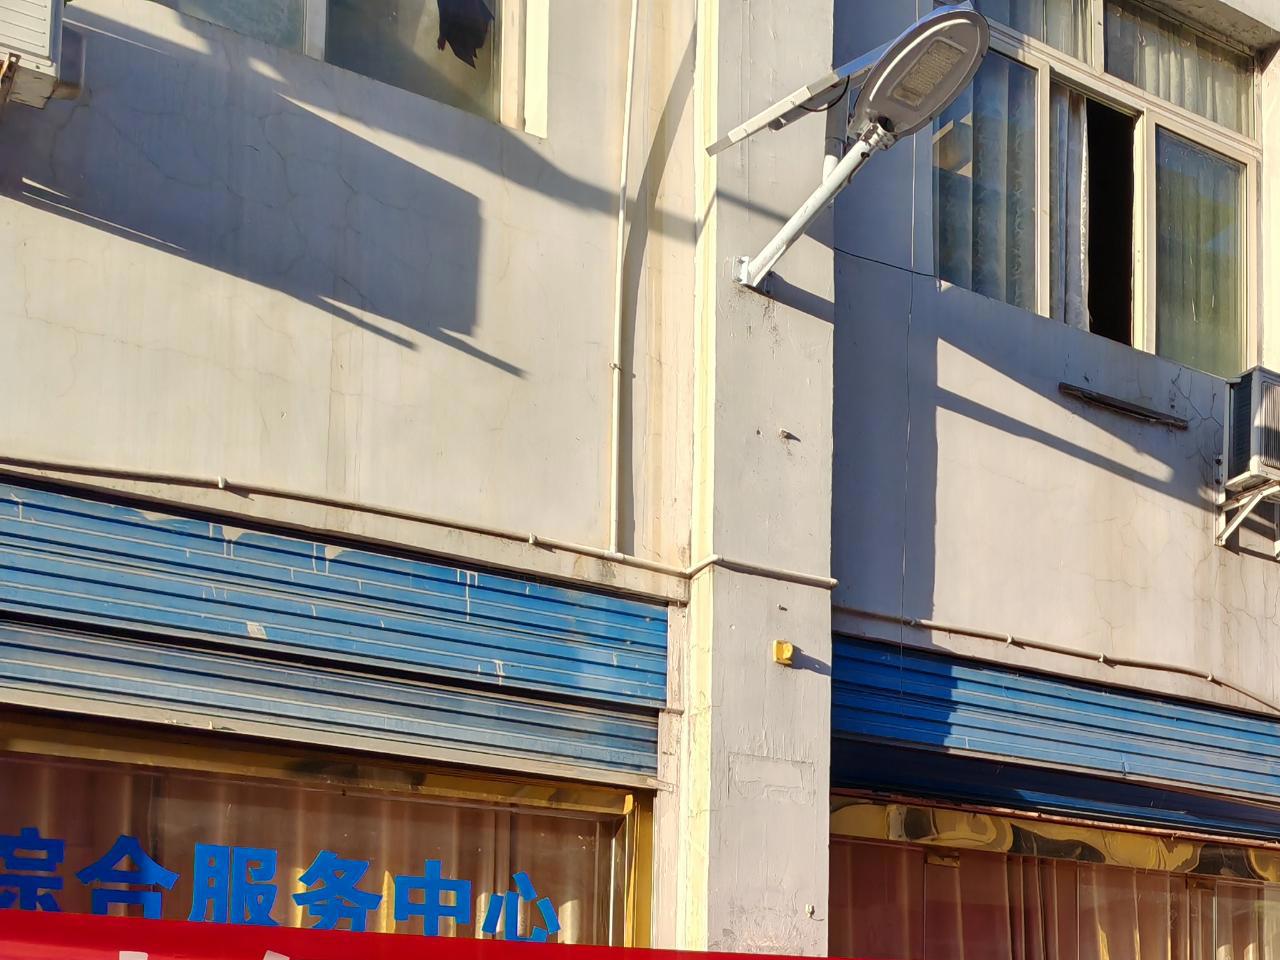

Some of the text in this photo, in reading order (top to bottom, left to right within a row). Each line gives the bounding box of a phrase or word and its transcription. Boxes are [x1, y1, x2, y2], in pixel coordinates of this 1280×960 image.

[0, 826, 561, 943] 综合服务中心
